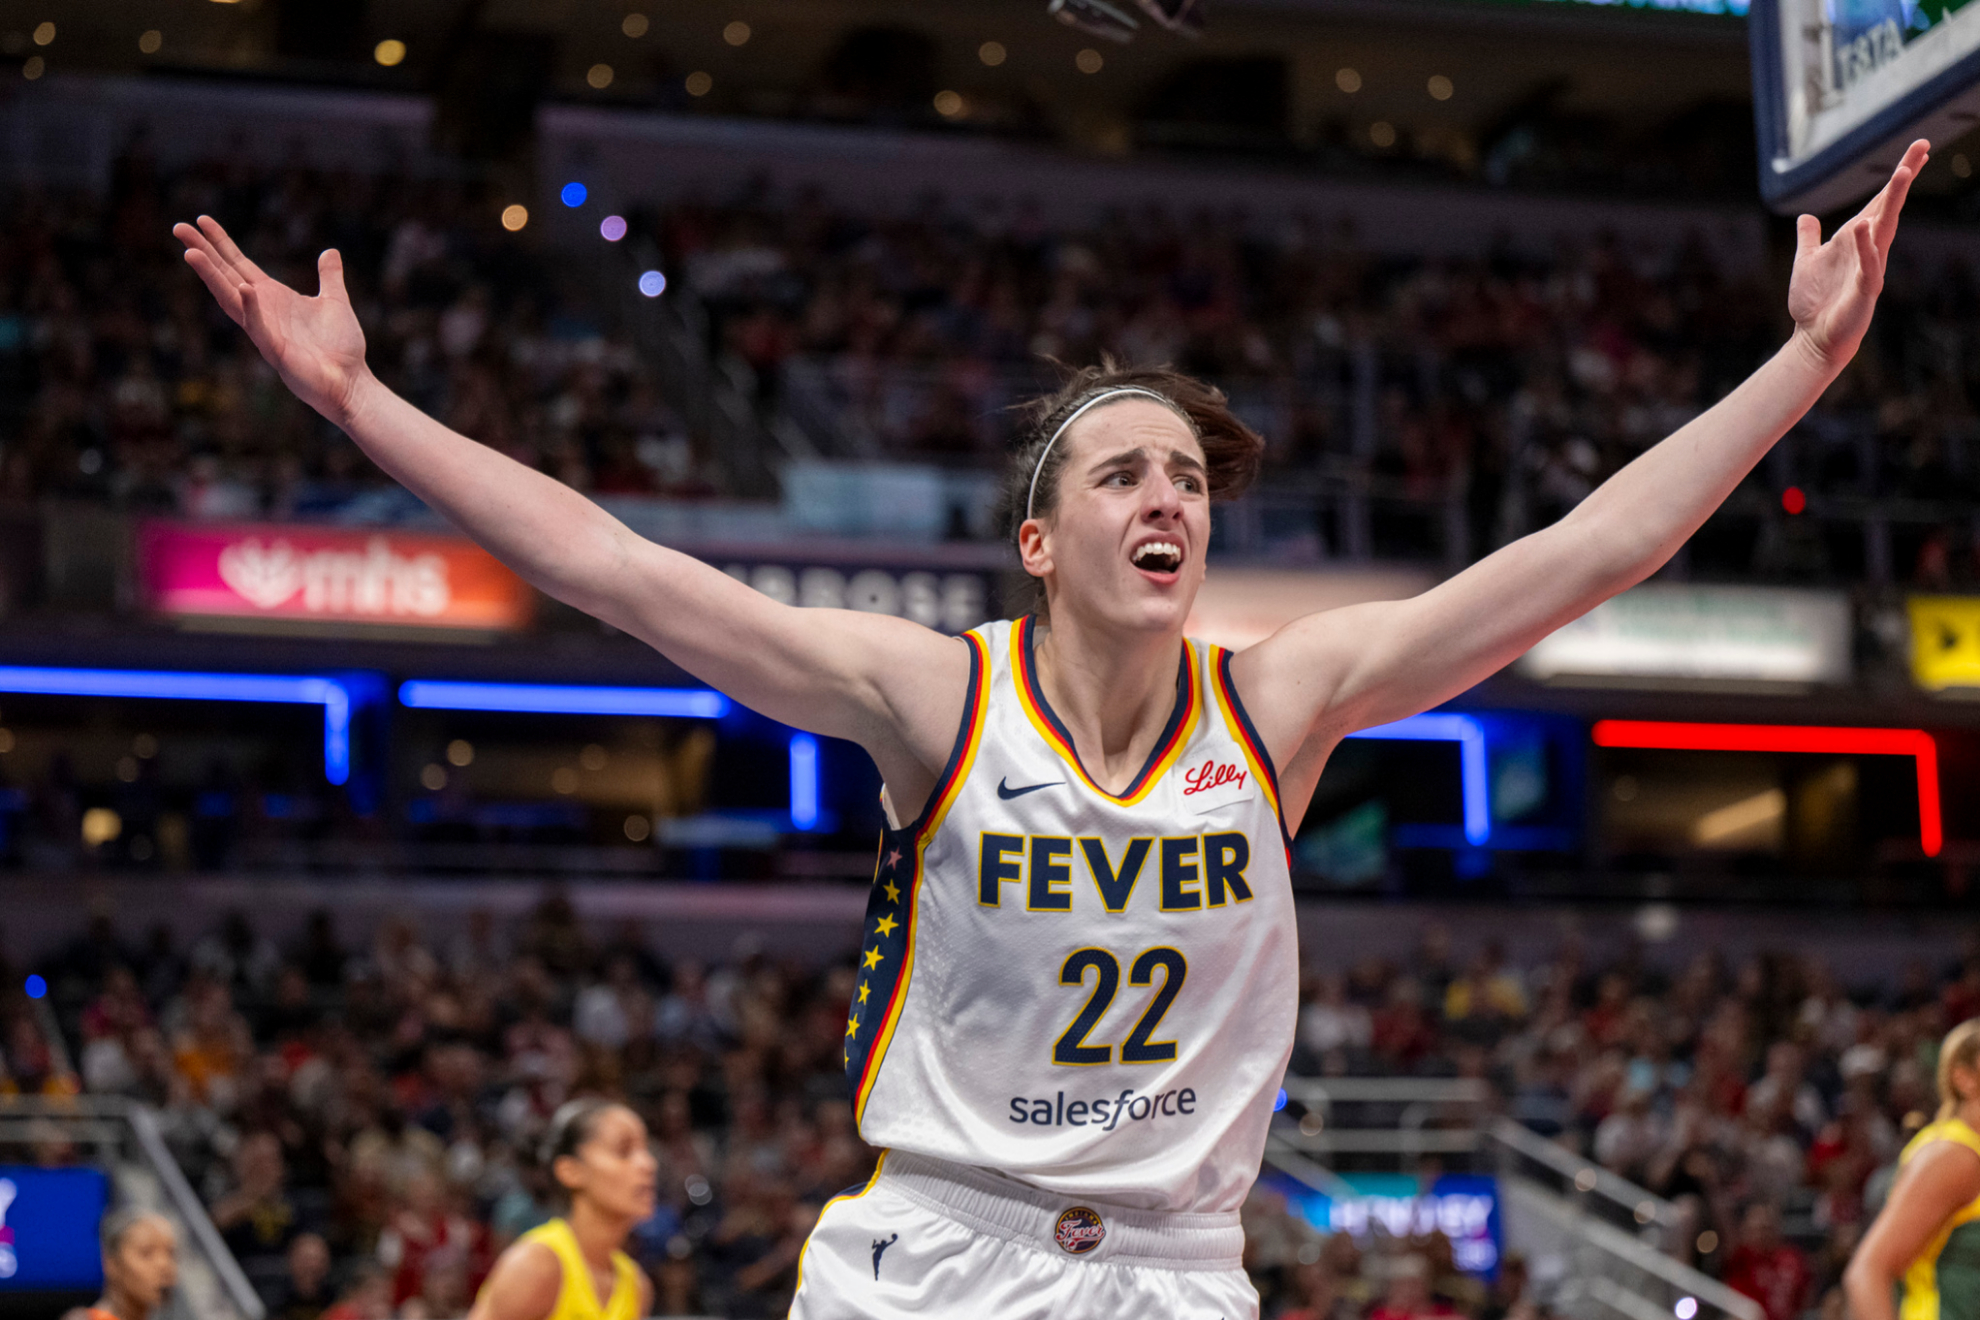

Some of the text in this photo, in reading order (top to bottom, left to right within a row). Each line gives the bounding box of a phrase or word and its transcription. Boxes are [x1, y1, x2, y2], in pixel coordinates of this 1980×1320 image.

[1184, 760, 1247, 795] Lilly
[978, 830, 1254, 913] FEVER
[1052, 945, 1189, 1067] 22
[1009, 1087, 1196, 1131] salesforce
[1055, 1218, 1106, 1241] Fever
